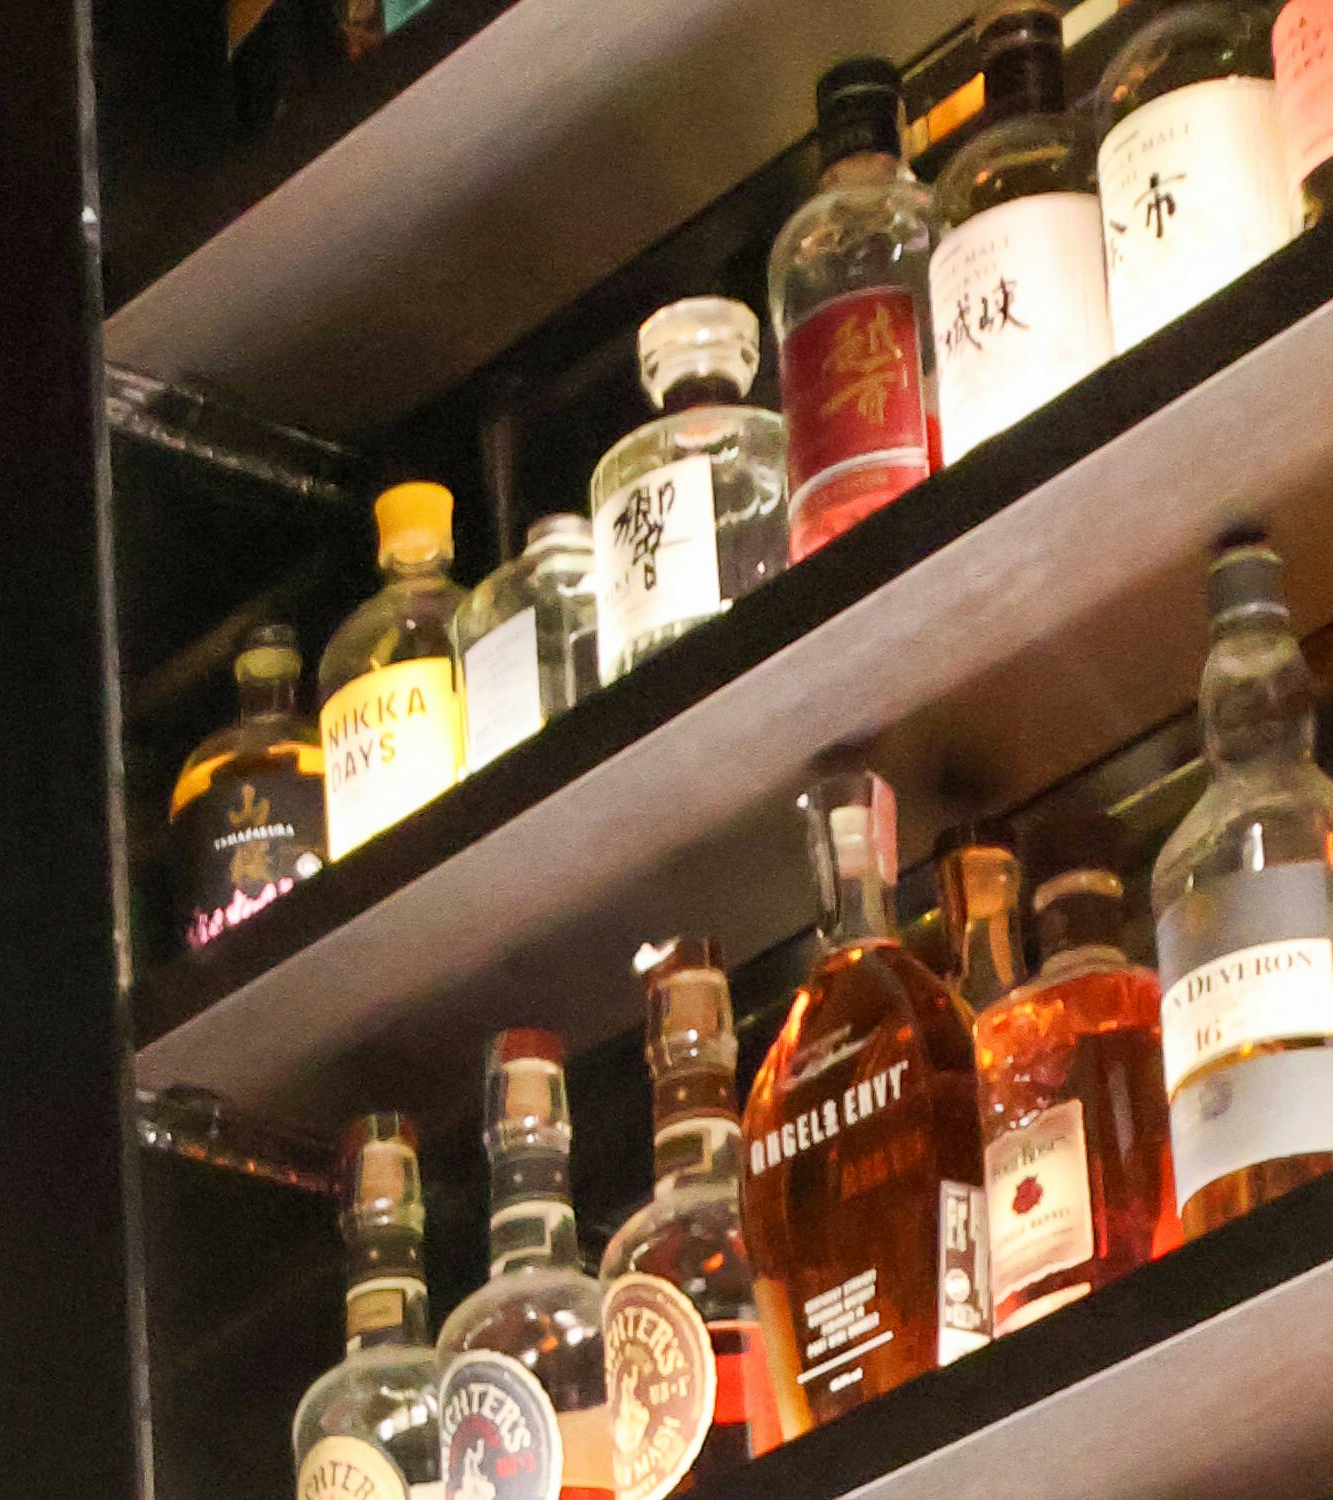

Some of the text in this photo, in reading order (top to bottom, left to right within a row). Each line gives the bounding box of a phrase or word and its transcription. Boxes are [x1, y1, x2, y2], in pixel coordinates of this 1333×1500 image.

[329, 687, 428, 747] NIKKA
[331, 731, 396, 793] DAYS
[1186, 950, 1314, 1003] DEVERON
[843, 1061, 905, 1126] ENVY
